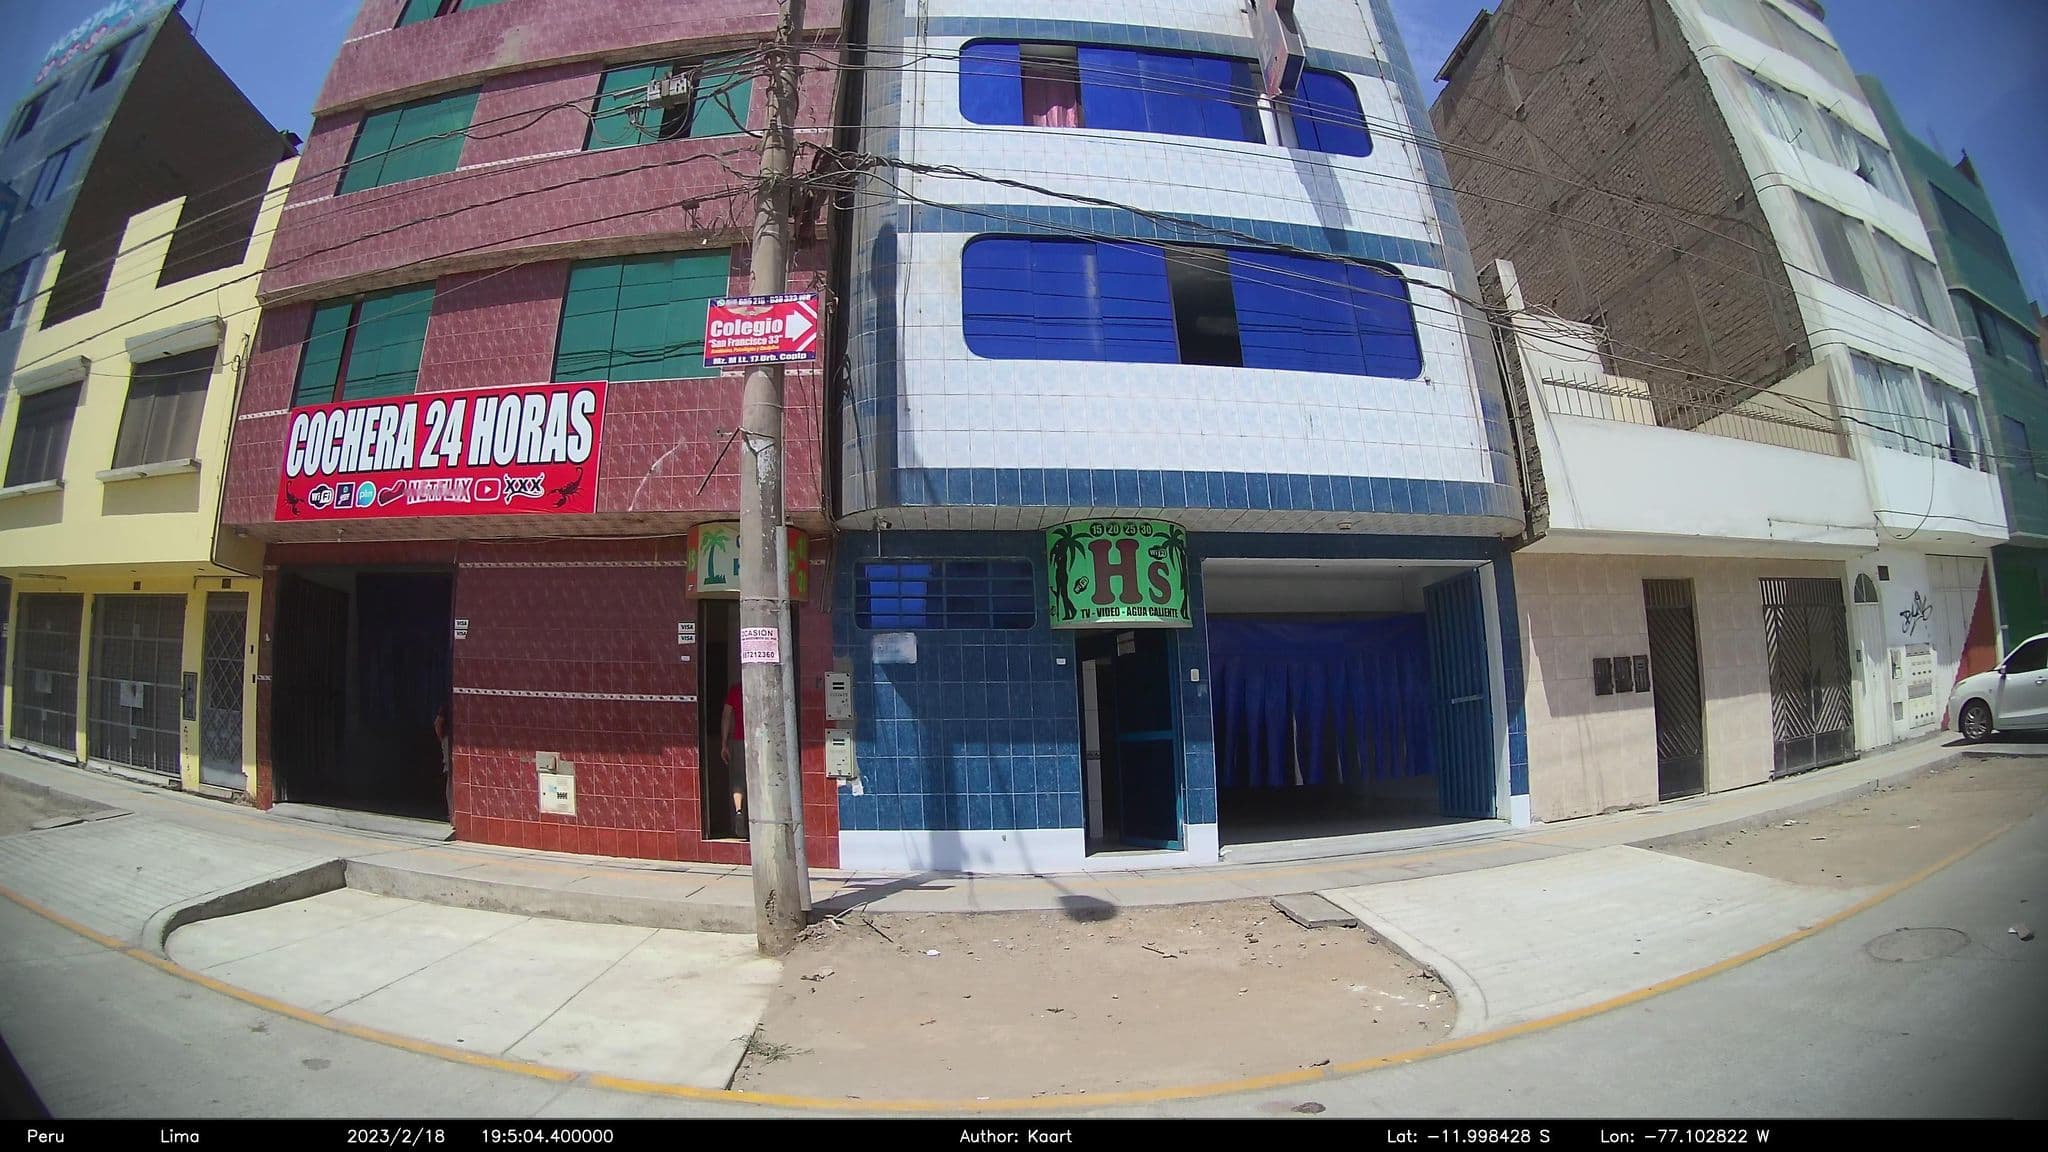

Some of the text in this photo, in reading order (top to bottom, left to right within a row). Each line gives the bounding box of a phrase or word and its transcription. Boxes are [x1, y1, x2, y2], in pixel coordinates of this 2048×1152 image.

[711, 318, 783, 337] Colegio
[727, 337, 767, 347] Francisco
[286, 390, 595, 477] COCHERA 24 HORAS
[406, 478, 473, 504] NETFLIX
[1091, 523, 1152, 535] 15 20 25 30
[1081, 608, 1091, 618] TV
[1096, 607, 1120, 617] VIDEO
[1126, 607, 1148, 617] AGUA
[1148, 608, 1179, 618] CALIENTE
